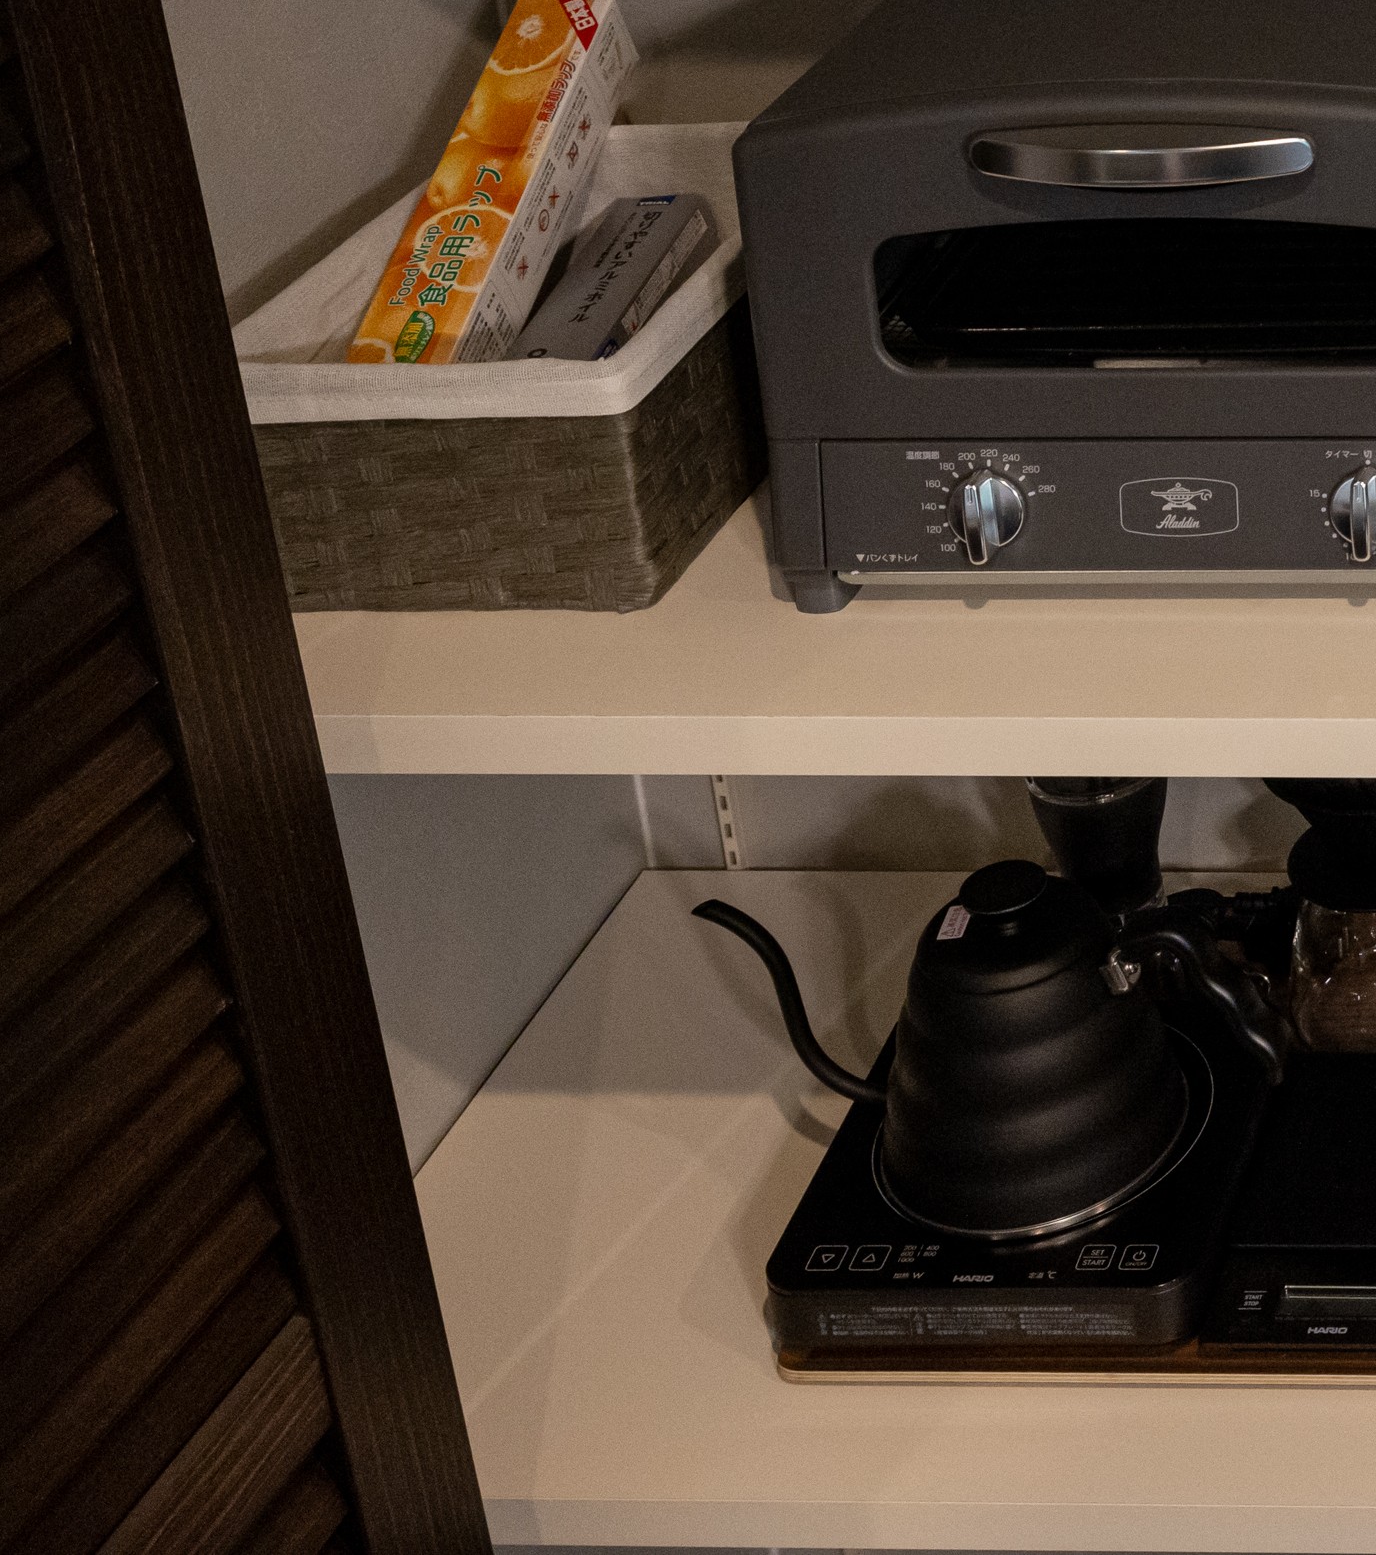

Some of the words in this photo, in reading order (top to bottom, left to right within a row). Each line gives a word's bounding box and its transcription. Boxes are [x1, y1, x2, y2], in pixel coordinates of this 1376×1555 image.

[418, 164, 502, 307] 食品用ラップ
[389, 267, 422, 306] Food
[409, 224, 442, 265] Wrap
[958, 452, 976, 461] 200
[980, 449, 998, 457] 220
[1002, 453, 1020, 462] 240
[1325, 450, 1359, 459] タイマー
[1363, 450, 1373, 459] 切
[940, 462, 955, 471] 180
[1022, 465, 1040, 474] 260
[925, 480, 940, 488] 160
[1038, 485, 1056, 494] 280
[1309, 489, 1320, 498] 15
[921, 502, 937, 511] 140
[1155, 514, 1200, 529] Aladdin
[926, 525, 942, 534] 120
[940, 544, 956, 552] 100
[866, 552, 918, 563] パンくずトレイ
[952, 1274, 996, 1284] HARIO
[1307, 1326, 1350, 1335] HARIO
